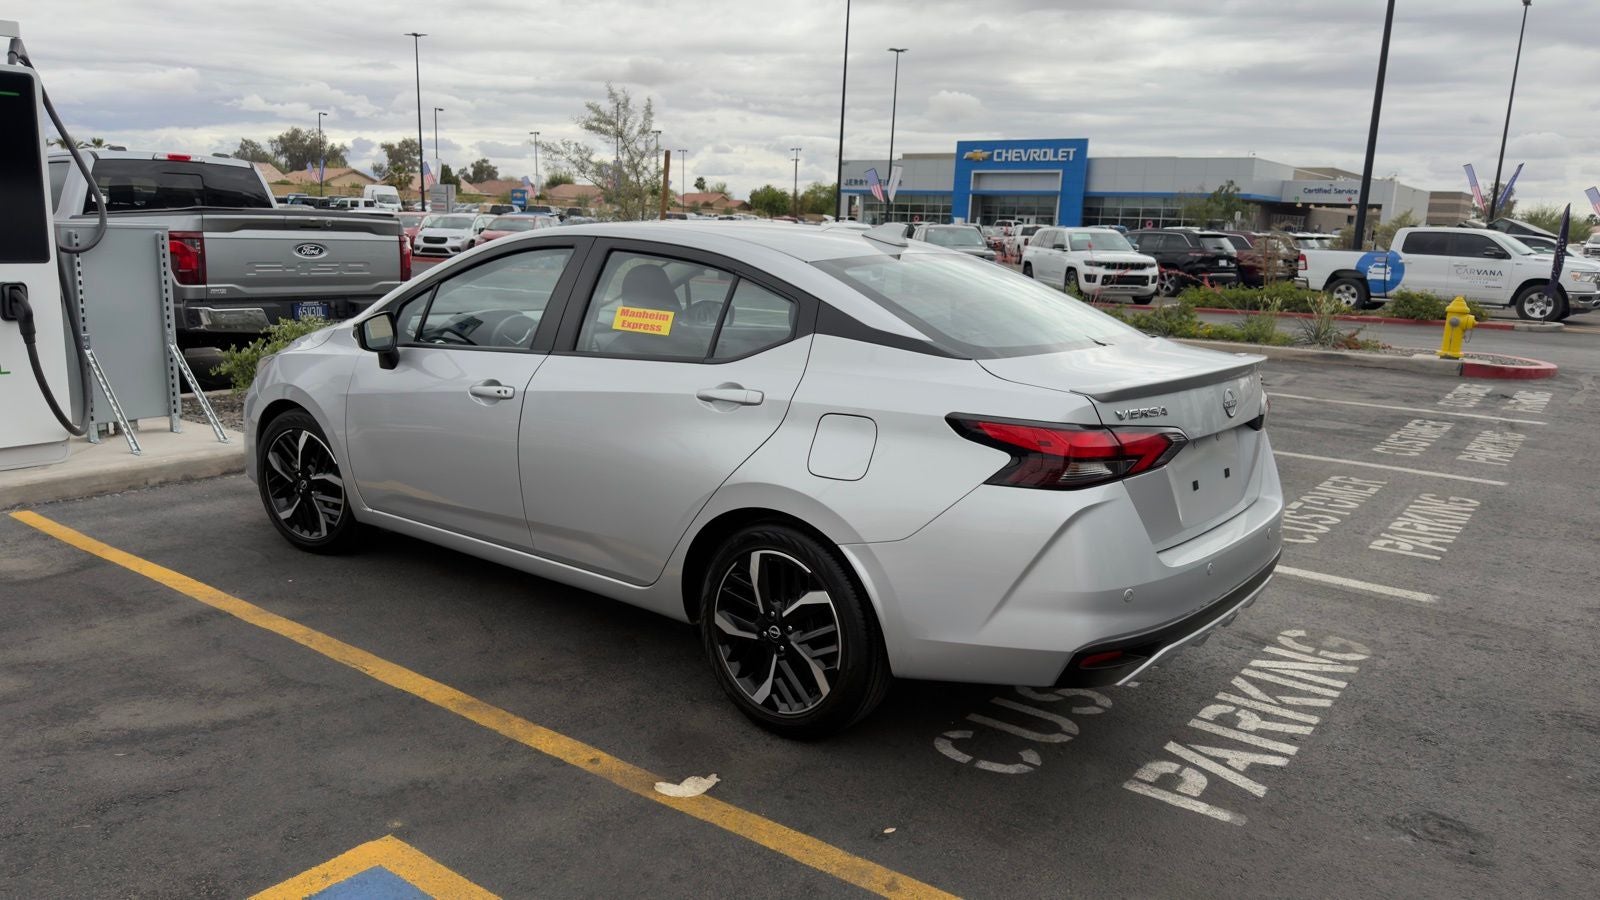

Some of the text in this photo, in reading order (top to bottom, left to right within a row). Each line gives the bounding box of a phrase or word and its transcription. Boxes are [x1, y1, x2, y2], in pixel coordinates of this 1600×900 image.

[993, 147, 1077, 162] CHEVROLET
[301, 245, 320, 255] Ford
[245, 261, 371, 276] F-150
[1455, 268, 1503, 277] CARVANA
[620, 308, 669, 322] Manheim
[621, 319, 663, 332] Express
[1114, 405, 1168, 421] VERSA
[1372, 418, 1456, 457] CUSTOMER
[1456, 430, 1527, 466] PARKING
[1368, 493, 1481, 561] PARKING
[934, 685, 1113, 775] CUS
[1122, 628, 1372, 827] PARKING
